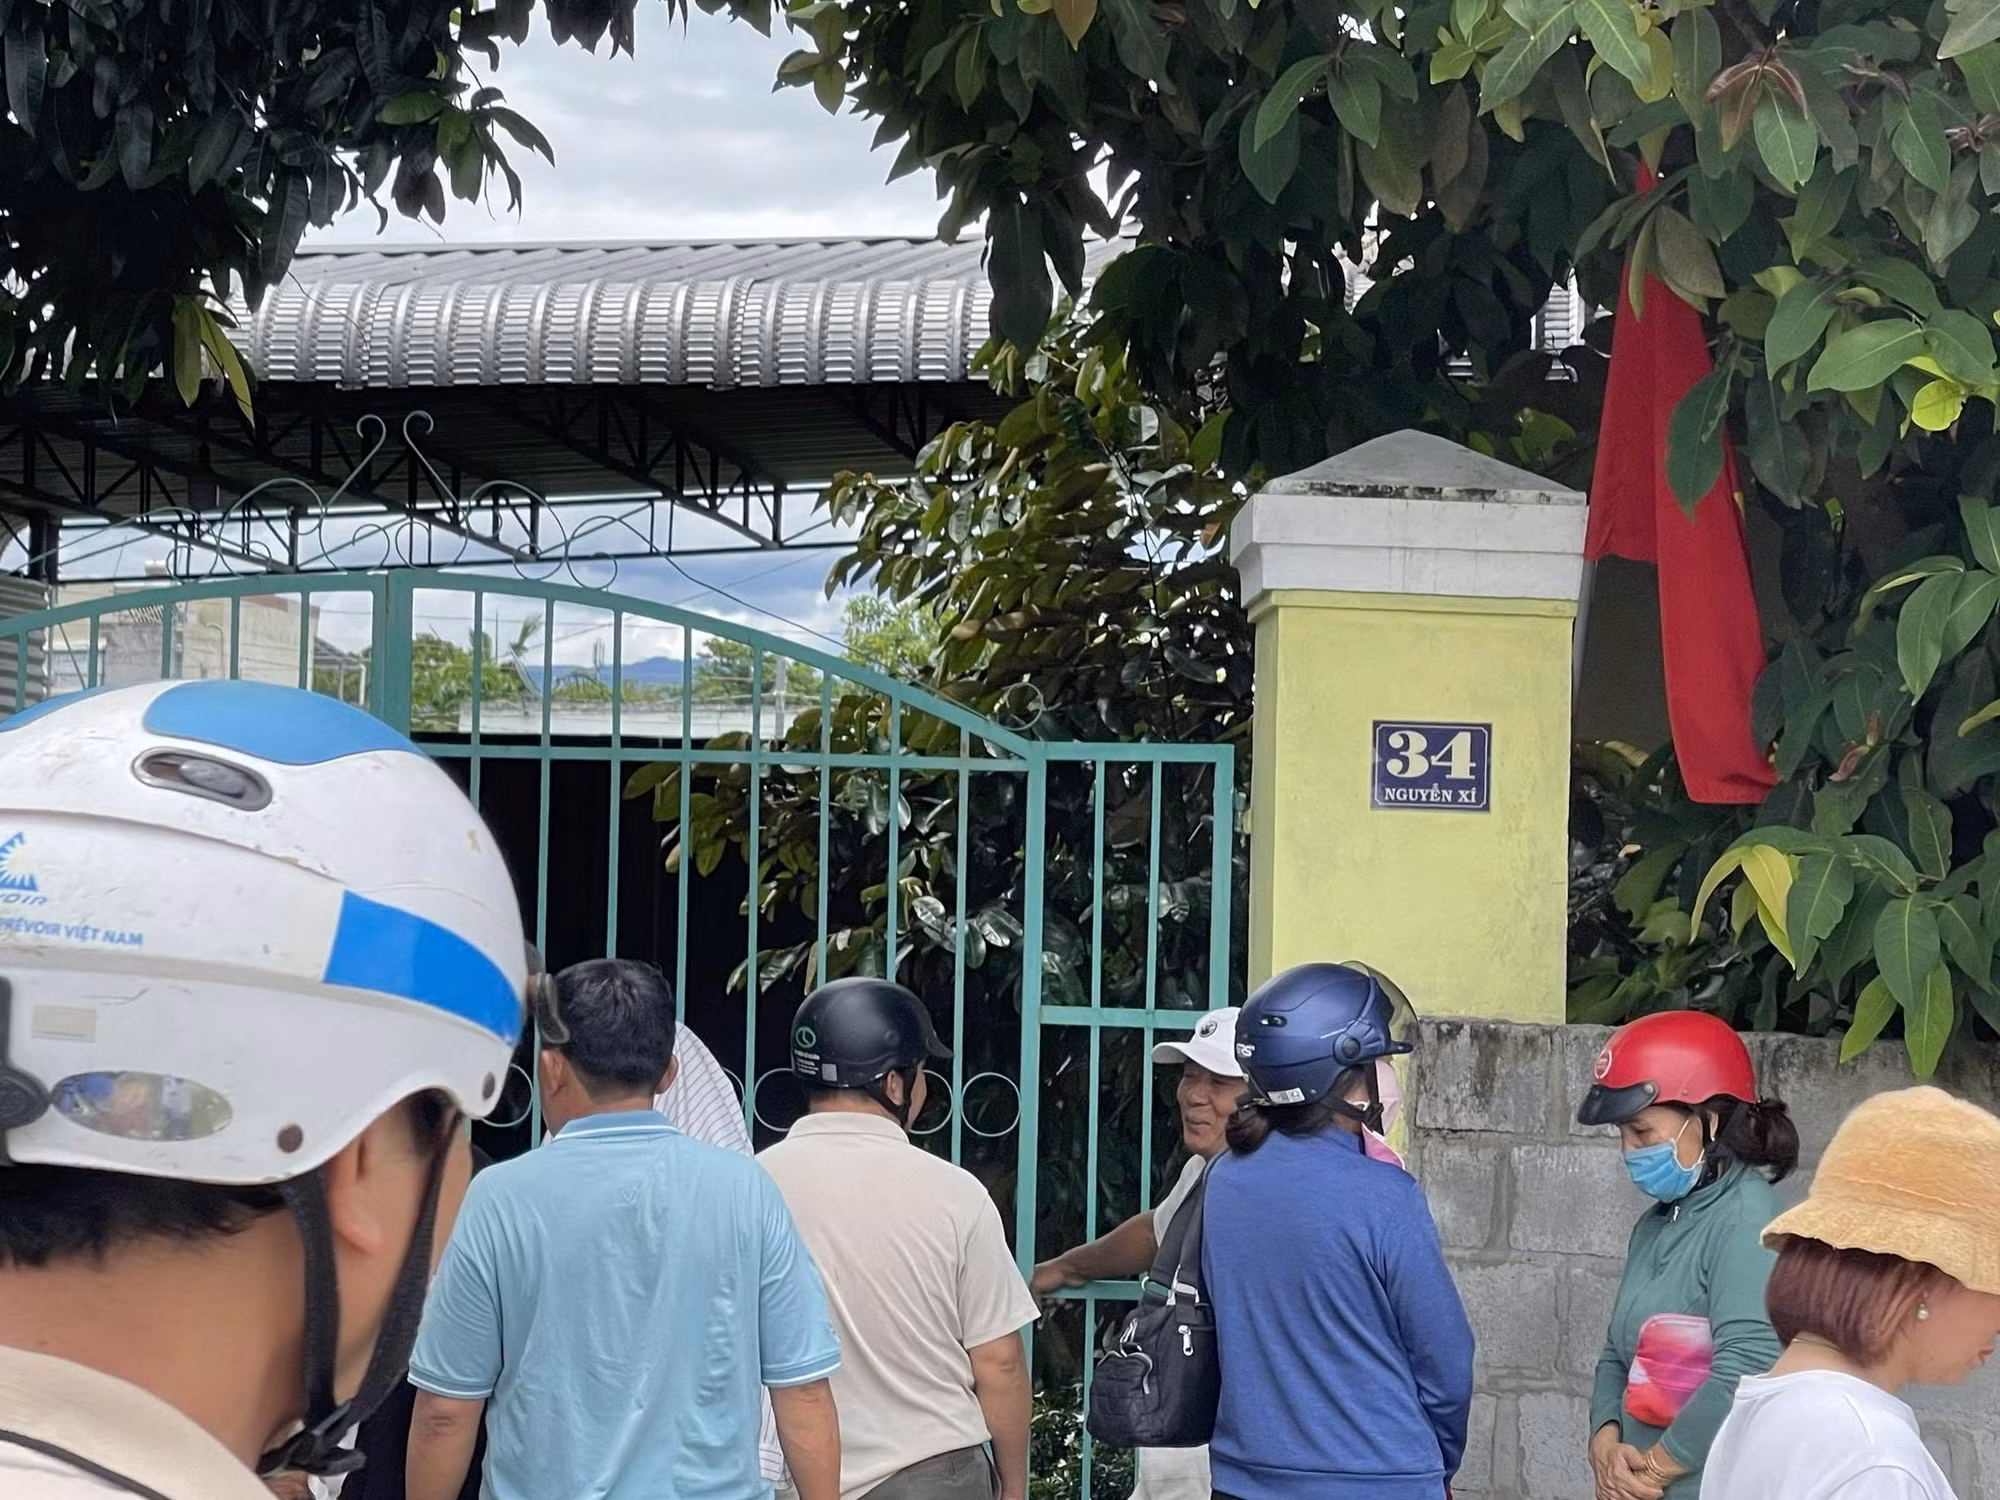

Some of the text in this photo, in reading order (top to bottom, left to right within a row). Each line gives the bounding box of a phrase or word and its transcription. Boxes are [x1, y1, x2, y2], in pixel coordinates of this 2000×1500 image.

[1386, 730, 1476, 779] 34
[1384, 783, 1453, 802] NGUYỄN
[64, 924, 100, 943] VIỆT
[103, 930, 143, 946] NAM
